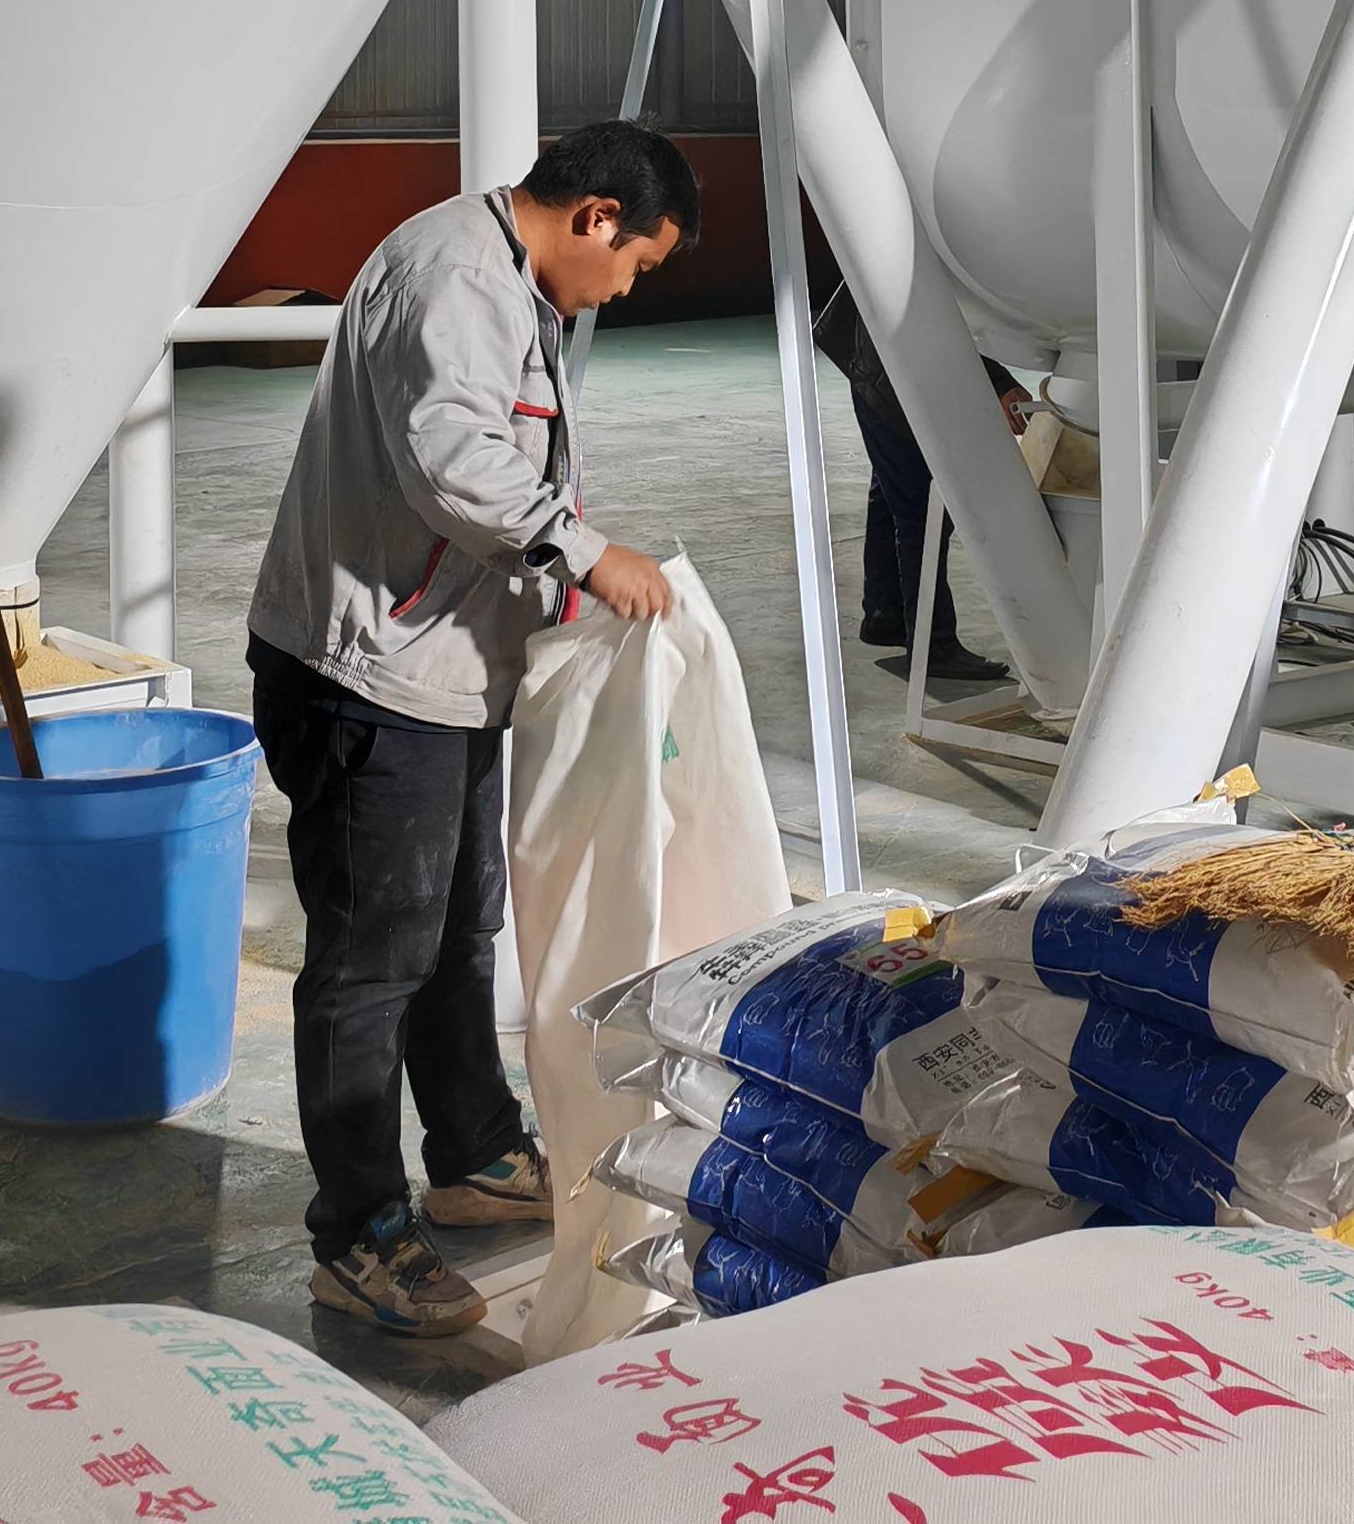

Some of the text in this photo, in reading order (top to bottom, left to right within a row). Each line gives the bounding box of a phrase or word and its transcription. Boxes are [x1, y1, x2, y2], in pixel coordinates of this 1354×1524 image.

[1174, 1271, 1275, 1321] 40kg
[598, 1348, 929, 1524] 奇面业
